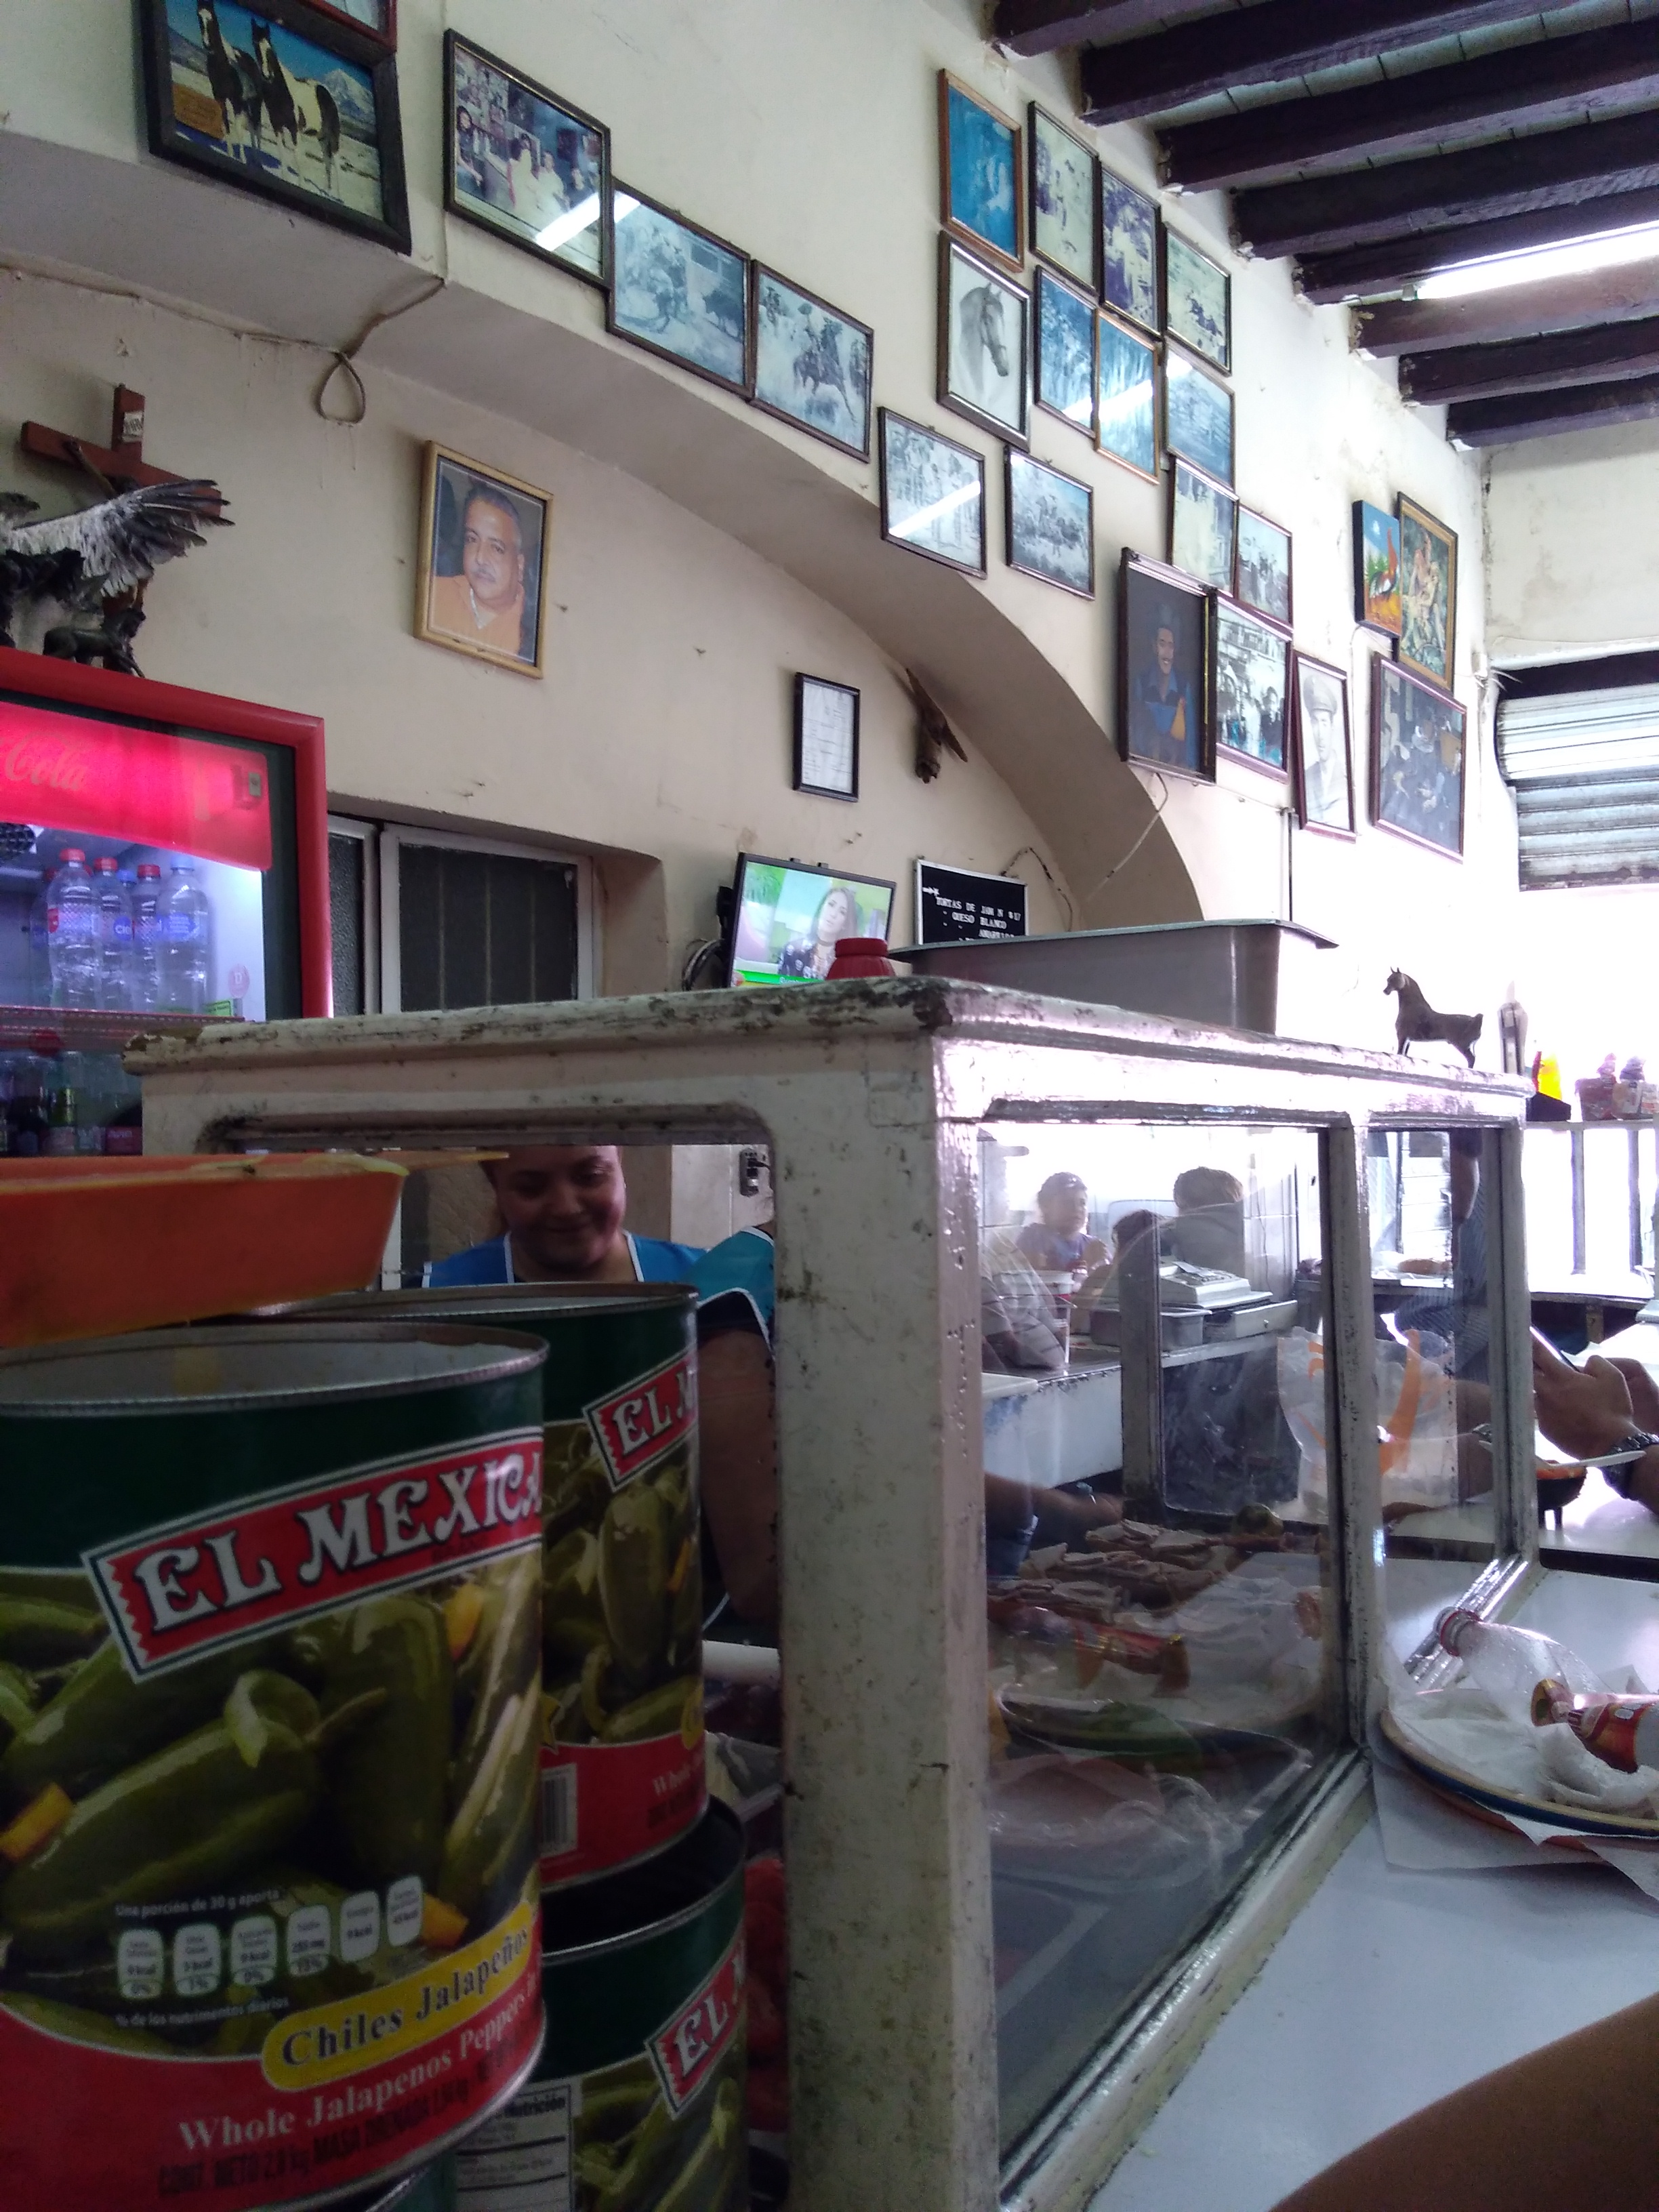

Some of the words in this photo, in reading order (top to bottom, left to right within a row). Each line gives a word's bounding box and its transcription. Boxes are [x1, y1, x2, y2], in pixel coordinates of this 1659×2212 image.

[935, 897, 962, 909] TORTAS
[966, 902, 976, 912] DE
[951, 912, 975, 924] QUESO
[979, 916, 1007, 929] BLANCO
[612, 1387, 673, 1456] EL
[133, 1530, 284, 1635] EL
[190, 1897, 207, 1911] de
[283, 2008, 404, 2066] Chiles
[416, 1928, 528, 2020] Jalapeños
[674, 1991, 730, 2078] EL
[178, 2108, 295, 2152] Whole
[306, 2049, 452, 2127] Jalapenos
